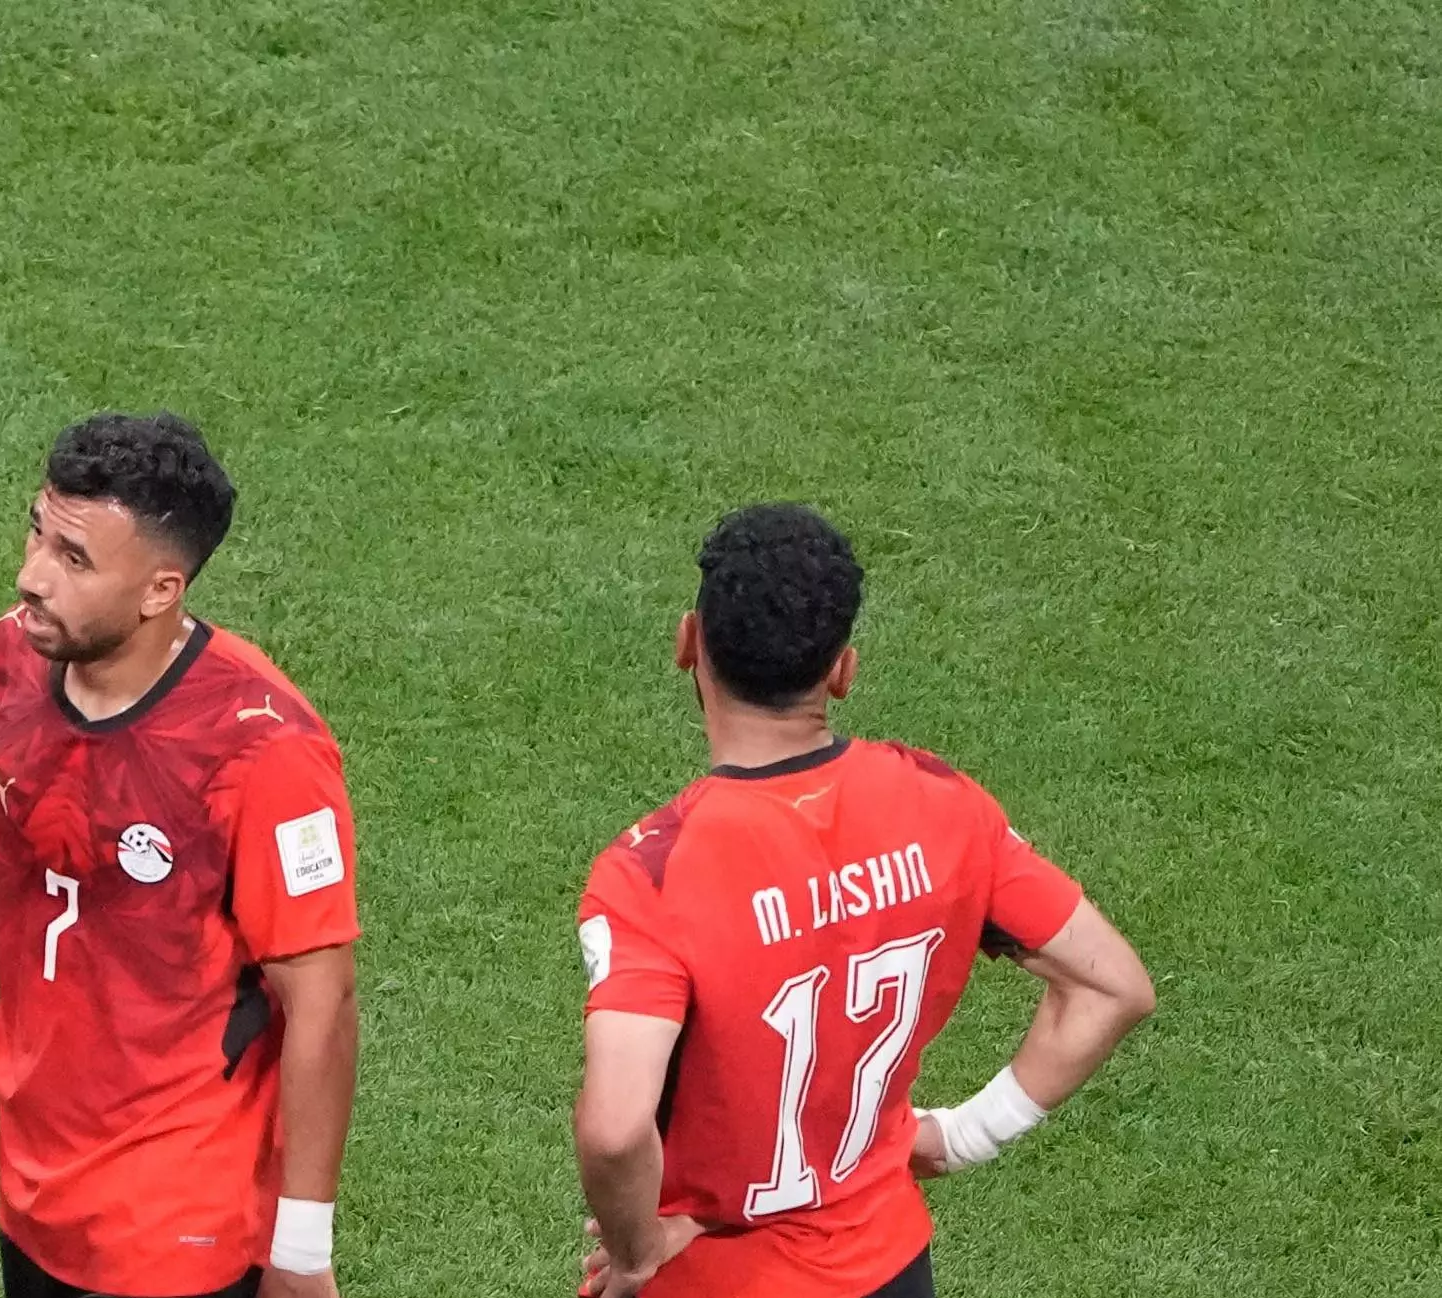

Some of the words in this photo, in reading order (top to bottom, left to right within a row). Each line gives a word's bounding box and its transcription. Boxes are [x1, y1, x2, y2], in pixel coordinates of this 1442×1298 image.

[43, 868, 80, 982] 7
[752, 886, 802, 945] M.
[808, 842, 933, 930] LASHIN
[743, 926, 946, 1221] 17
